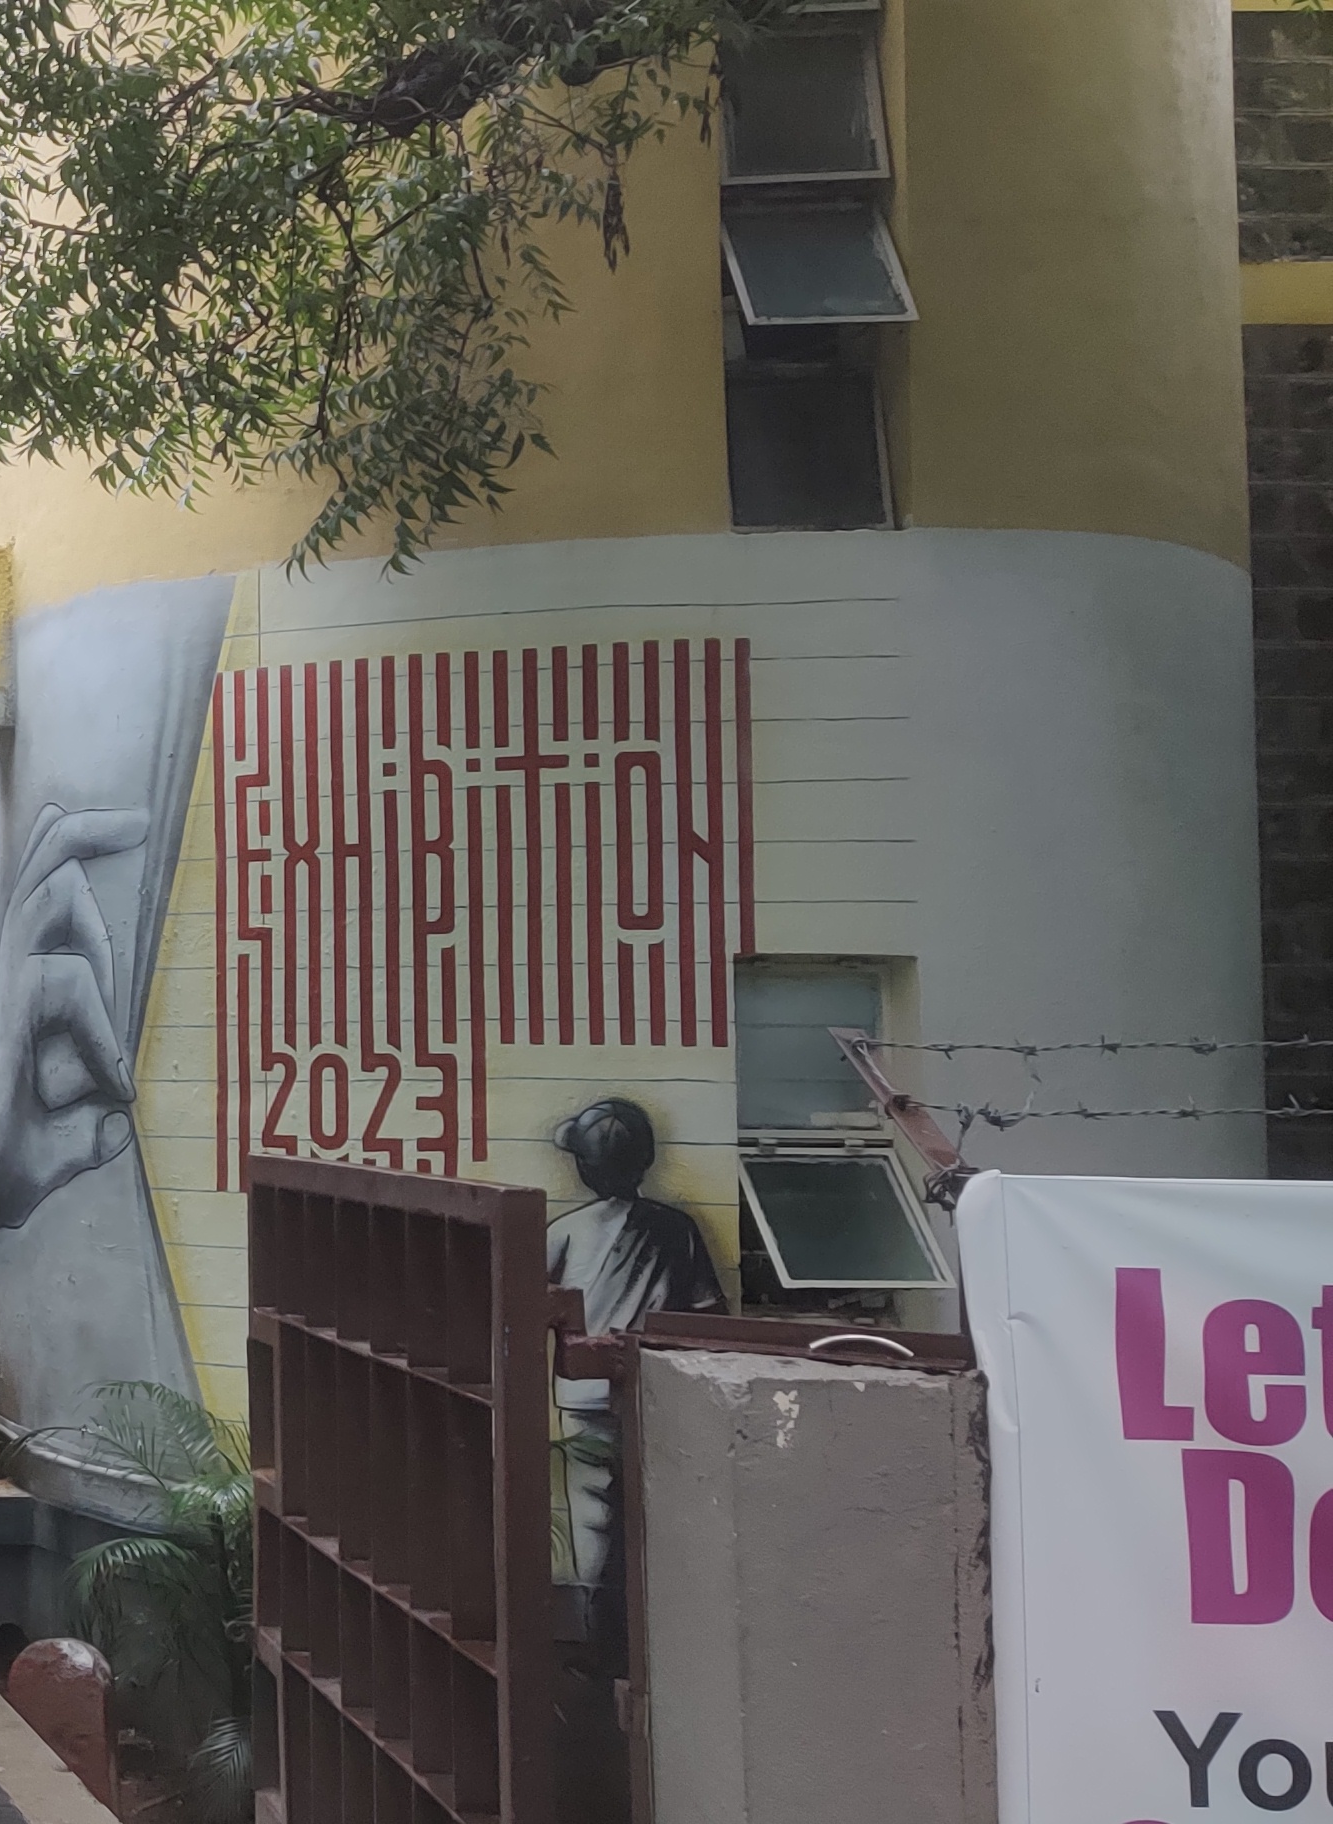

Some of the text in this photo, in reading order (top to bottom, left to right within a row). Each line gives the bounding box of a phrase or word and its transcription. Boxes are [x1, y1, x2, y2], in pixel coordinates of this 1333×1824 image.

[261, 1051, 458, 1153] 2023
[1115, 1267, 1333, 1447] Le
[1181, 1449, 1333, 1626] D
[1152, 1709, 1333, 1812] Yo
